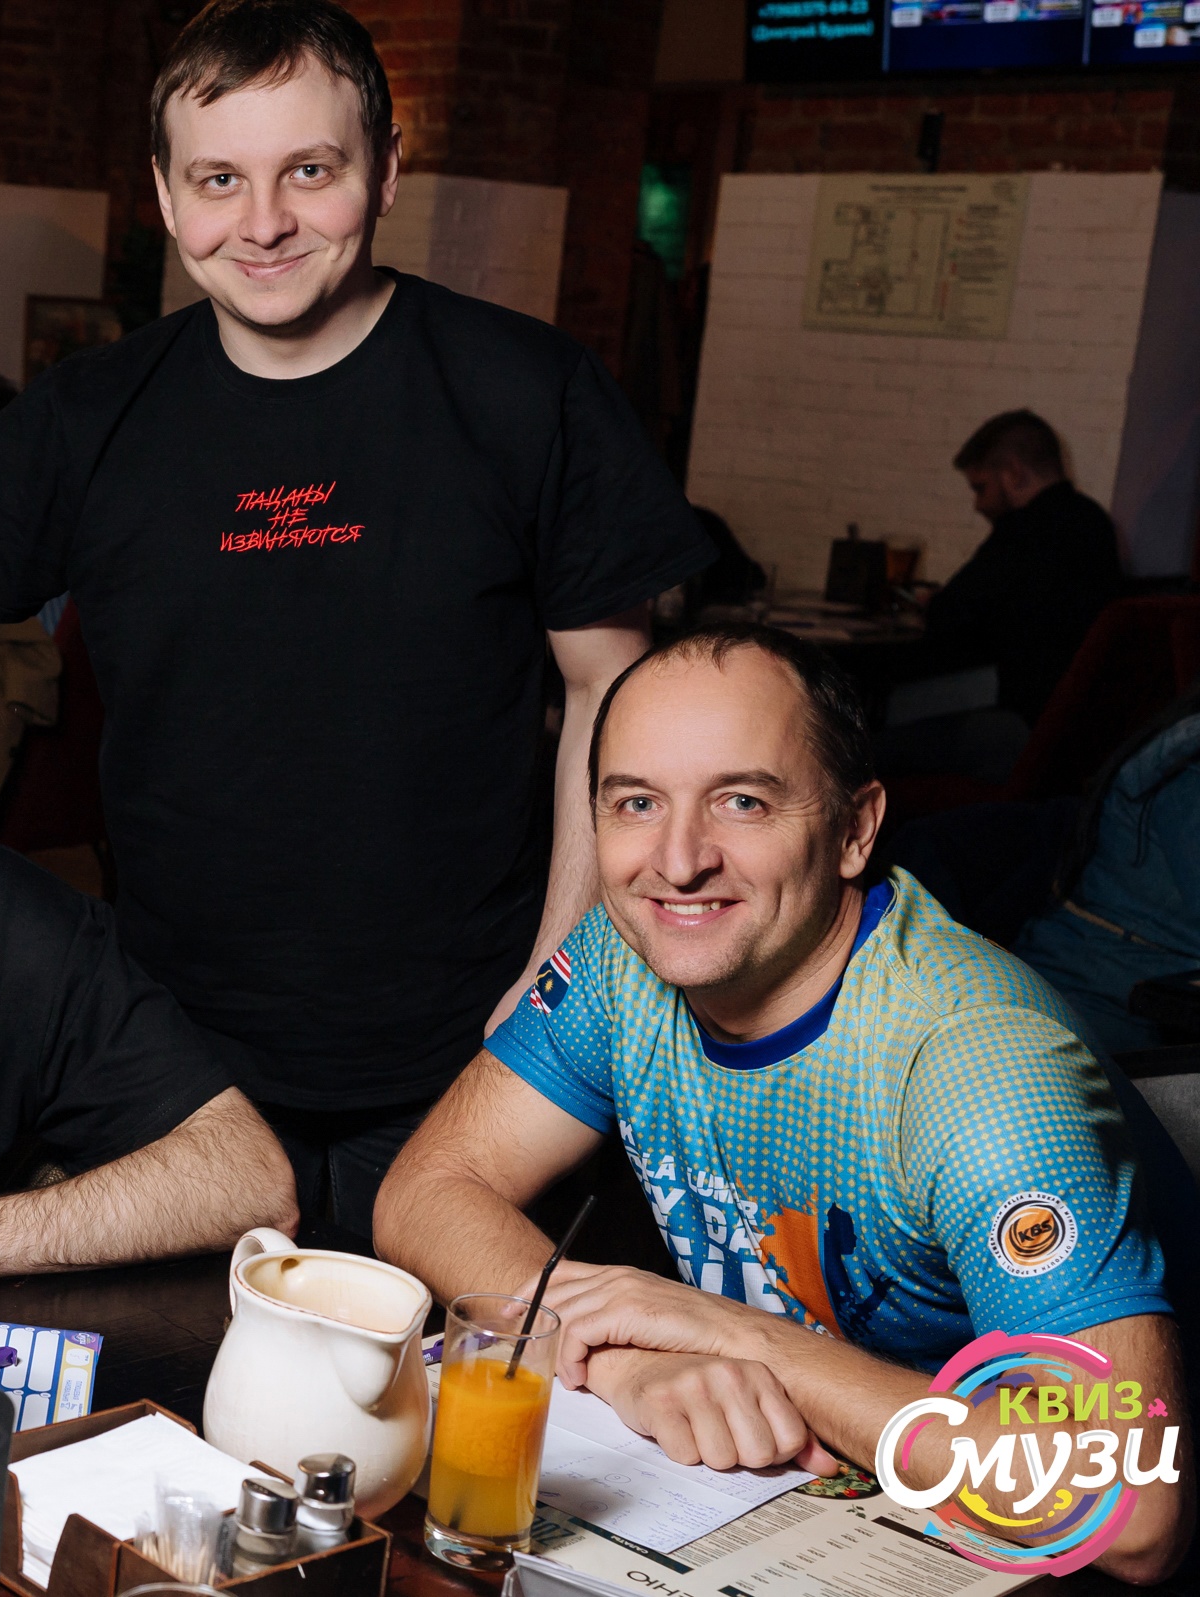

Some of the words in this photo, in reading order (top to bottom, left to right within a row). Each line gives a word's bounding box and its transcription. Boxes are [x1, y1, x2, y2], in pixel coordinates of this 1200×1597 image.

[235, 481, 336, 512] ПАЦАНЫ
[268, 507, 308, 530] НЕ
[220, 523, 365, 552] ИЗВИНЯЮТСЯ
[1018, 1219, 1053, 1243] KBS
